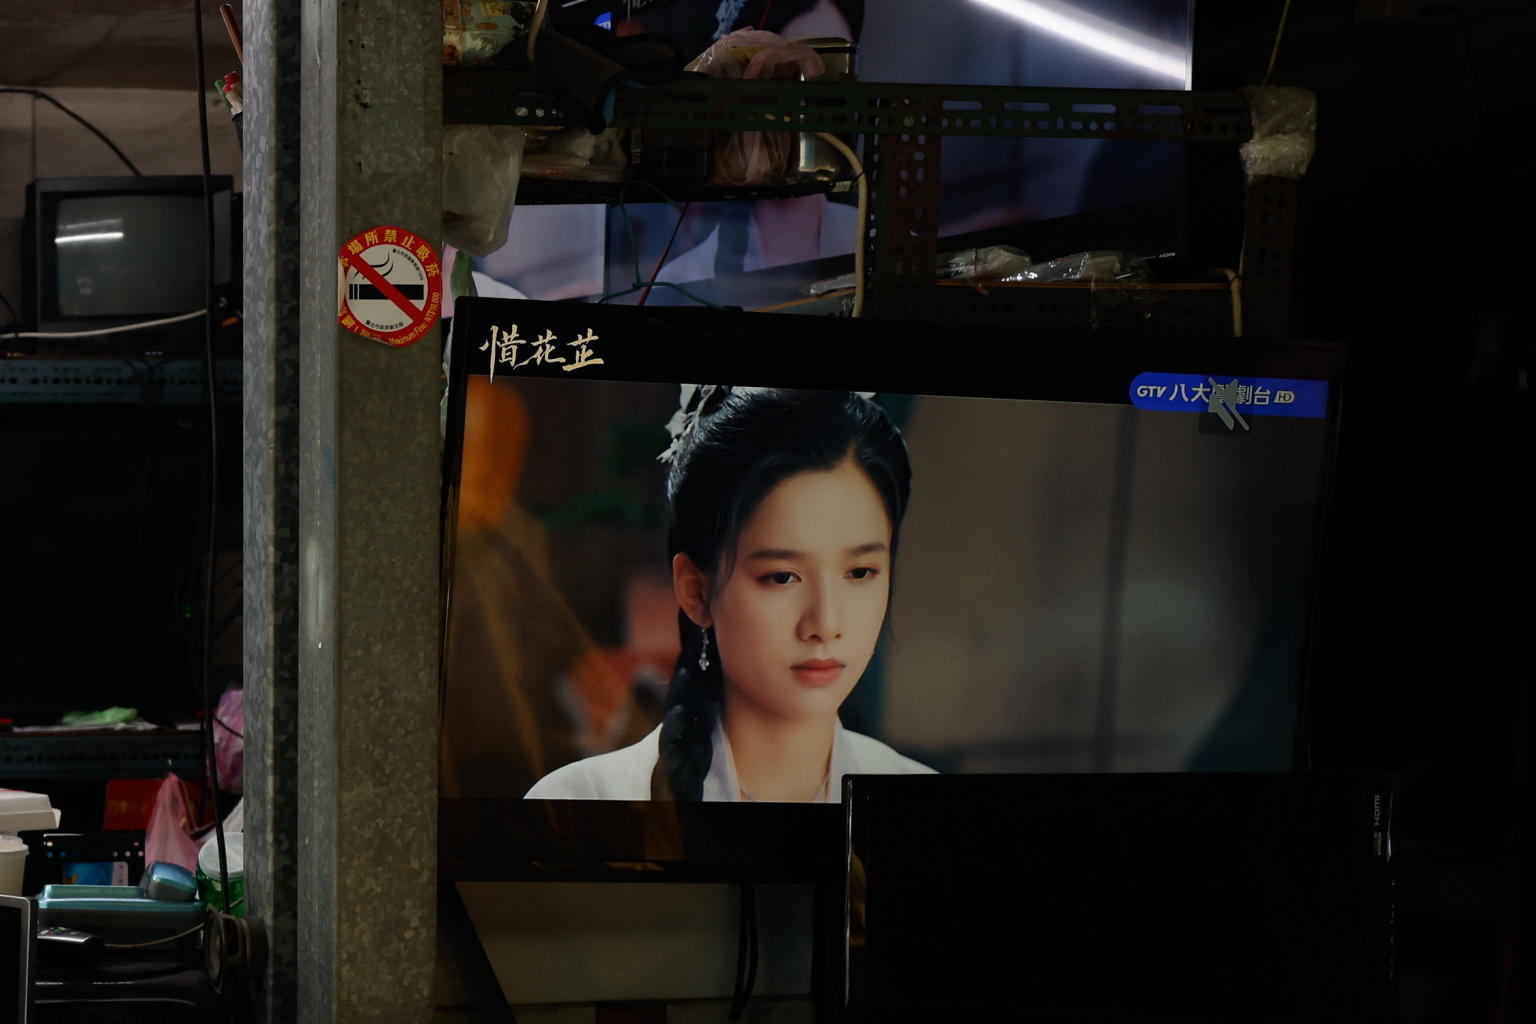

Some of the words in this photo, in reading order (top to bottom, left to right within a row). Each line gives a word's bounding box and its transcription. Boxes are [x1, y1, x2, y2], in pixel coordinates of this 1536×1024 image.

[480, 324, 604, 384] 惜花芷
[1136, 385, 1167, 398] GTV
